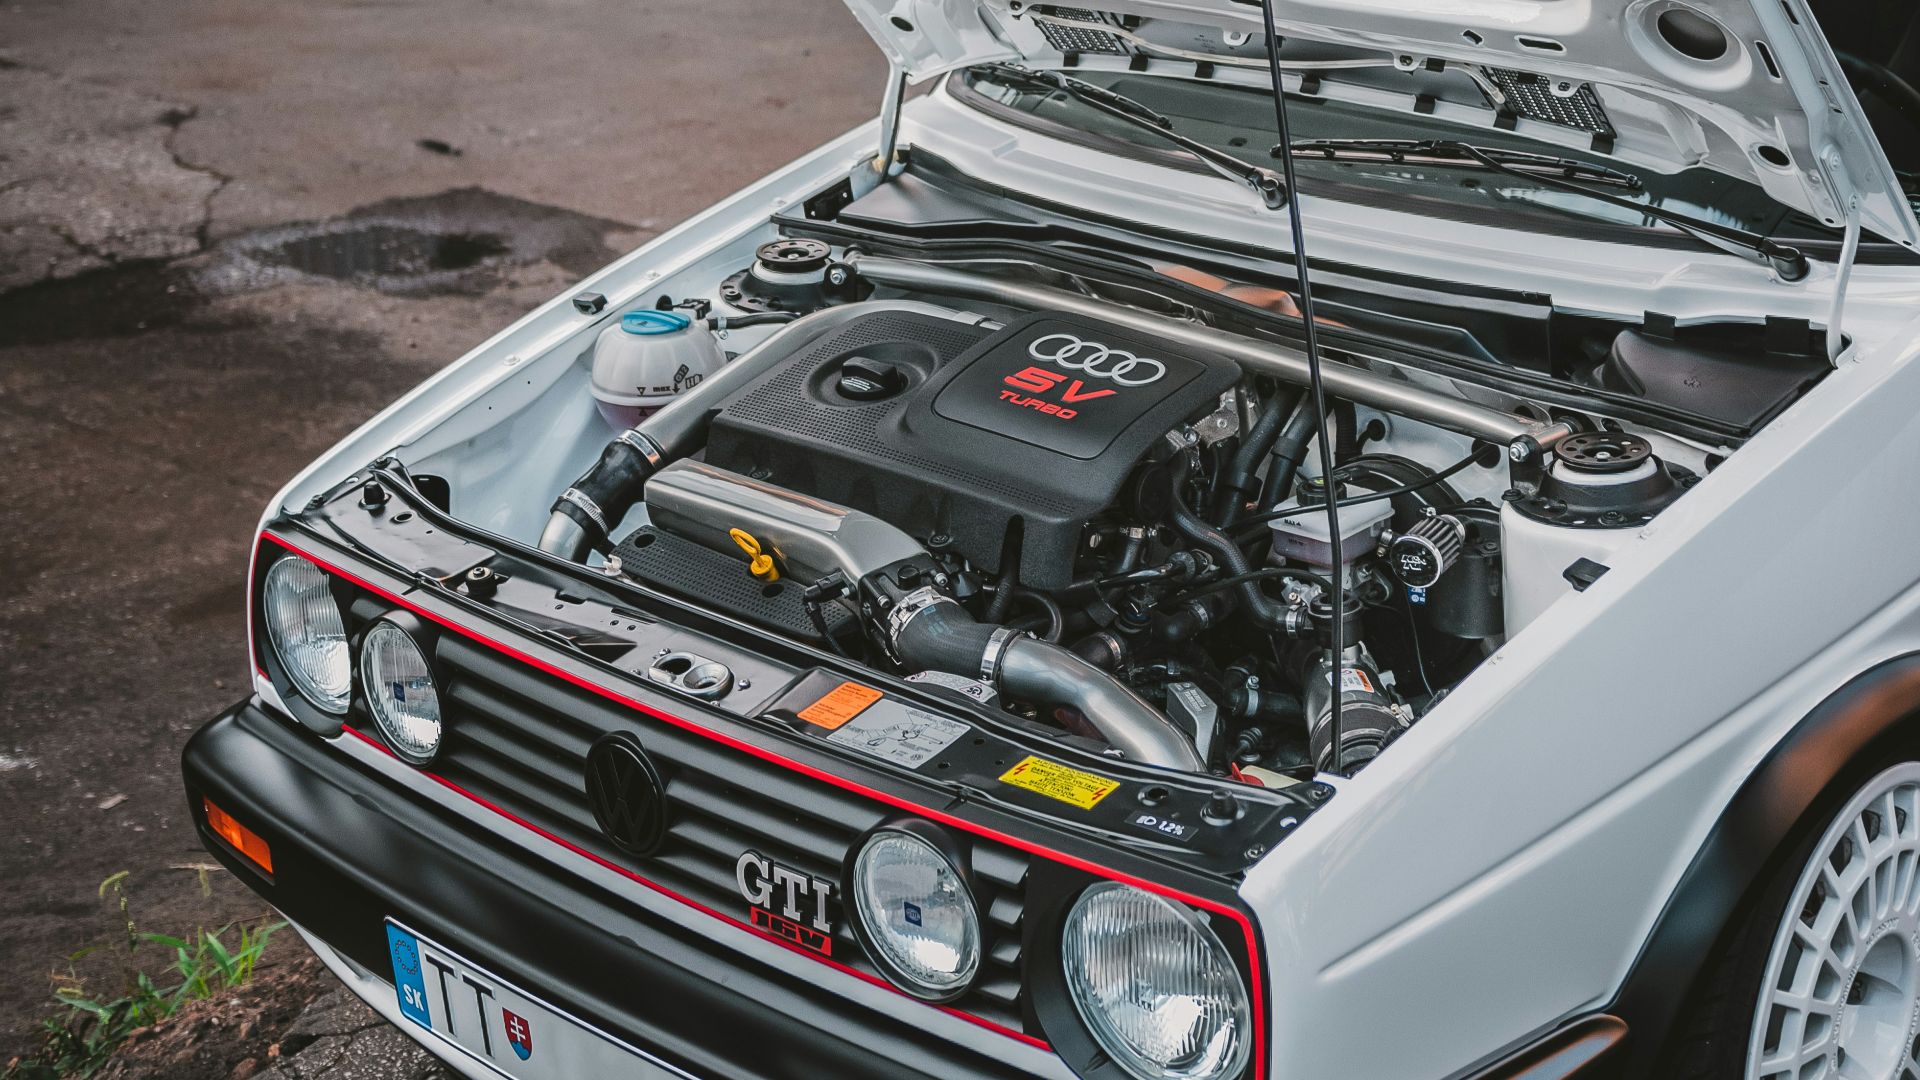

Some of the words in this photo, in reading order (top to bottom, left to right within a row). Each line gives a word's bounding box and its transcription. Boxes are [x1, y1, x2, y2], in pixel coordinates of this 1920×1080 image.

[1000, 389, 1078, 419] TURBO
[736, 850, 831, 934] GTI
[754, 910, 827, 951] 16V
[402, 983, 425, 1012] SK
[424, 951, 496, 1058] TT
